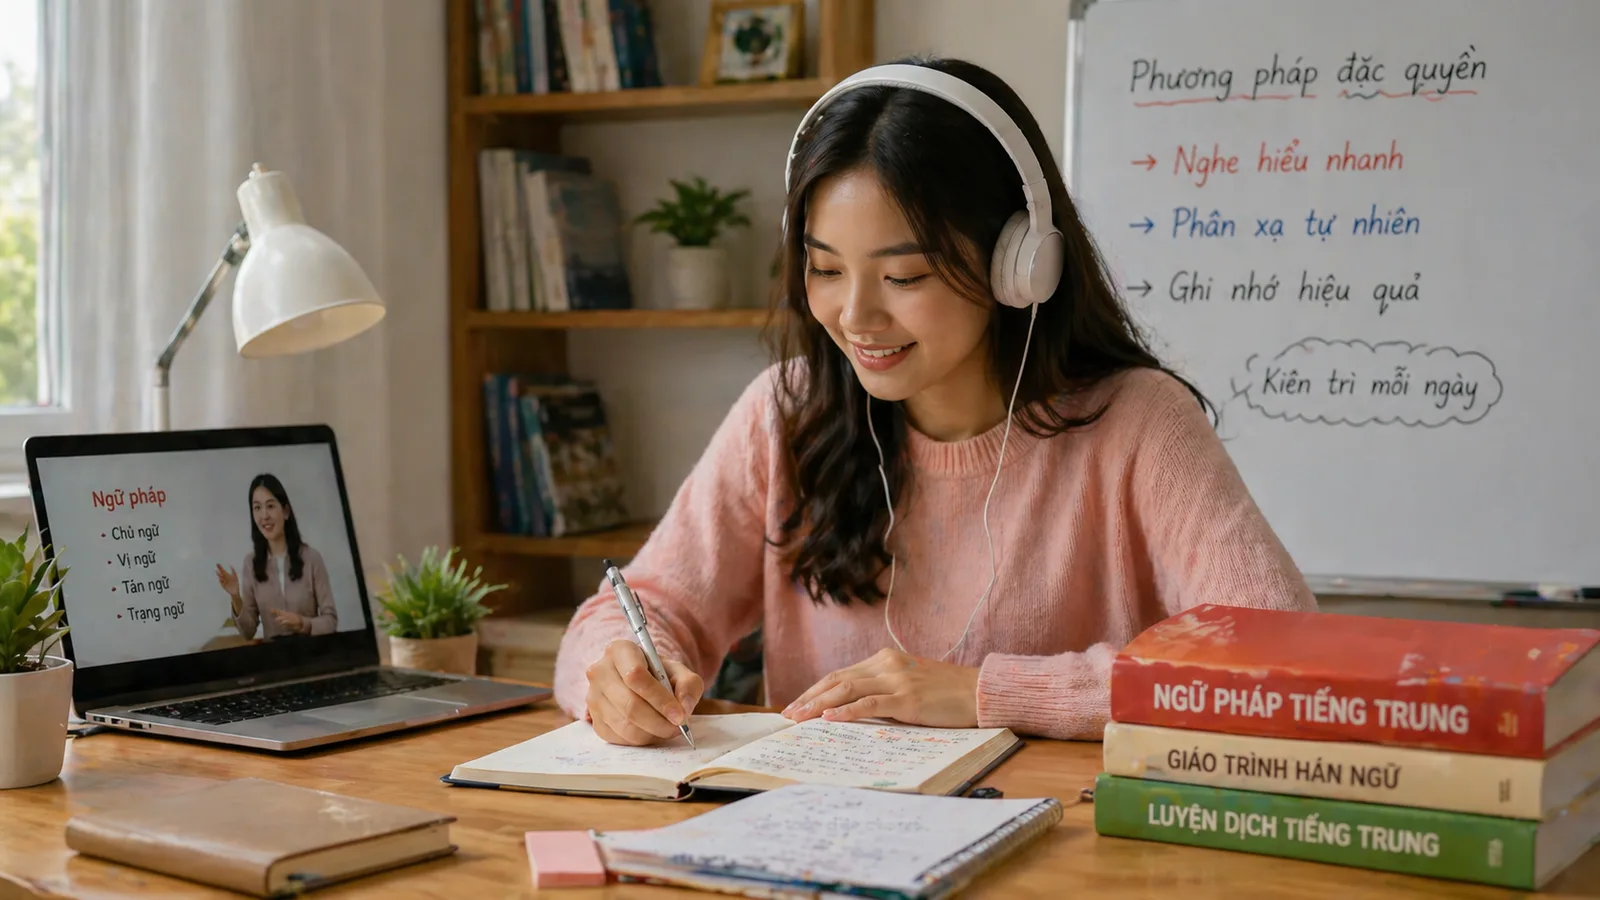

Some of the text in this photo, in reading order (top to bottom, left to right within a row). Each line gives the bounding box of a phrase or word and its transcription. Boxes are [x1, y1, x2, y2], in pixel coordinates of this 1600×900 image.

[1131, 45, 1487, 102] Phương pháp đặc quyền
[1174, 138, 1404, 188] Nghe hiểu nhanh
[1172, 204, 1421, 243] Phân xạ tự nhiên
[1170, 270, 1421, 316] Ghi nhớ hiệu quả
[1262, 367, 1479, 411] Kiên trì mỗi ngày
[92, 486, 167, 512] Ngữ pháp
[138, 524, 160, 541] ngữ
[117, 551, 156, 569] Vị ngữ
[148, 576, 170, 594] ngữ
[127, 601, 185, 624] Trạng ngữ
[1153, 680, 1208, 713] NGỮ
[1213, 684, 1283, 719] PHÁP
[1288, 686, 1367, 725] TIẾNG
[1374, 699, 1470, 734] TRUNG
[1167, 747, 1401, 789] GIÁO TRÌNH HÁN NGỮ
[1148, 801, 1440, 857] LUYỆN DỊCH TIẾNG TRUNG
